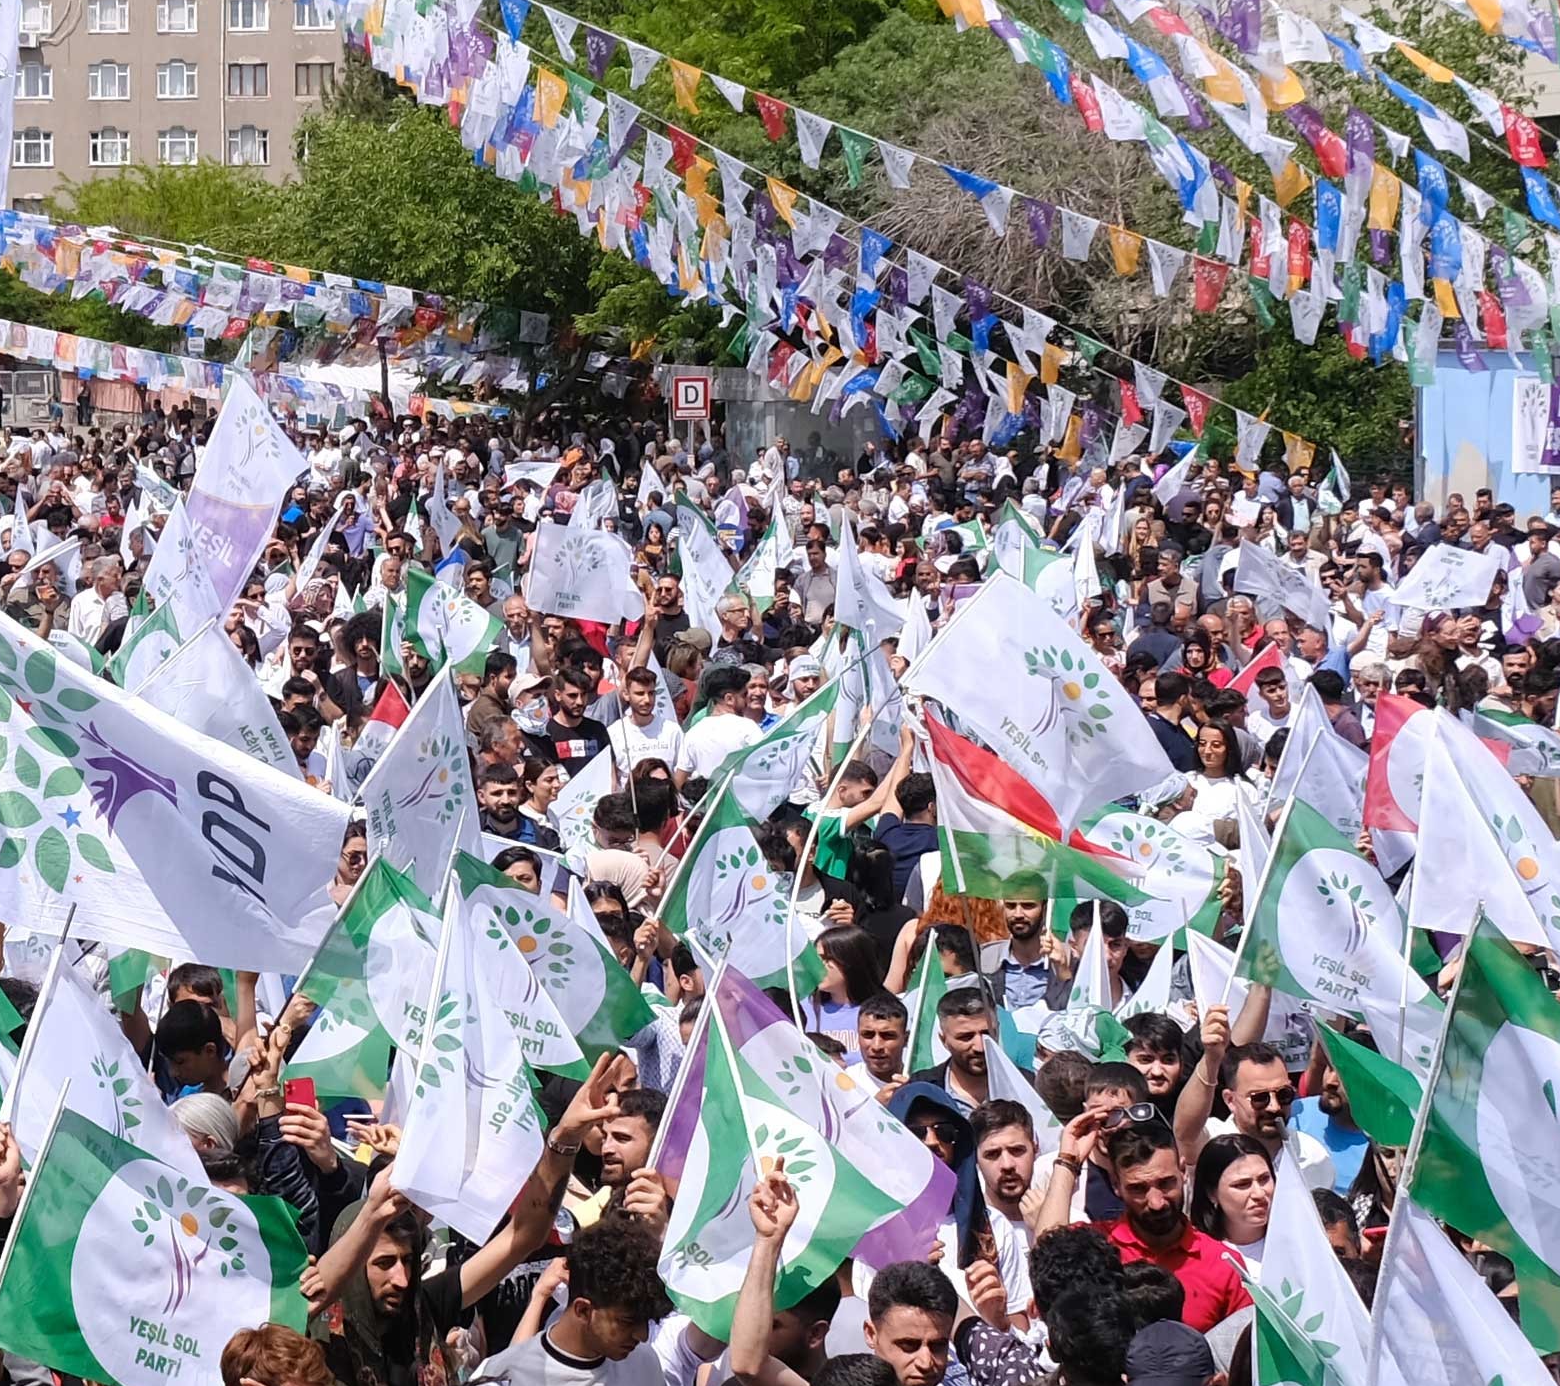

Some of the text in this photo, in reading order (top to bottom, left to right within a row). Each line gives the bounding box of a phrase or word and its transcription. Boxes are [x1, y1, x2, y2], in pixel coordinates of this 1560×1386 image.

[684, 385, 699, 404] D
[999, 716, 1032, 755] YEŞİL
[1135, 909, 1155, 922] SOL
[1311, 953, 1374, 991] YEŞİL SOL
[1315, 976, 1357, 1001] PARTİ
[534, 1017, 563, 1038] SOL
[129, 1315, 201, 1358] YEŞİL SOL
[134, 1348, 182, 1377] PARTİ
